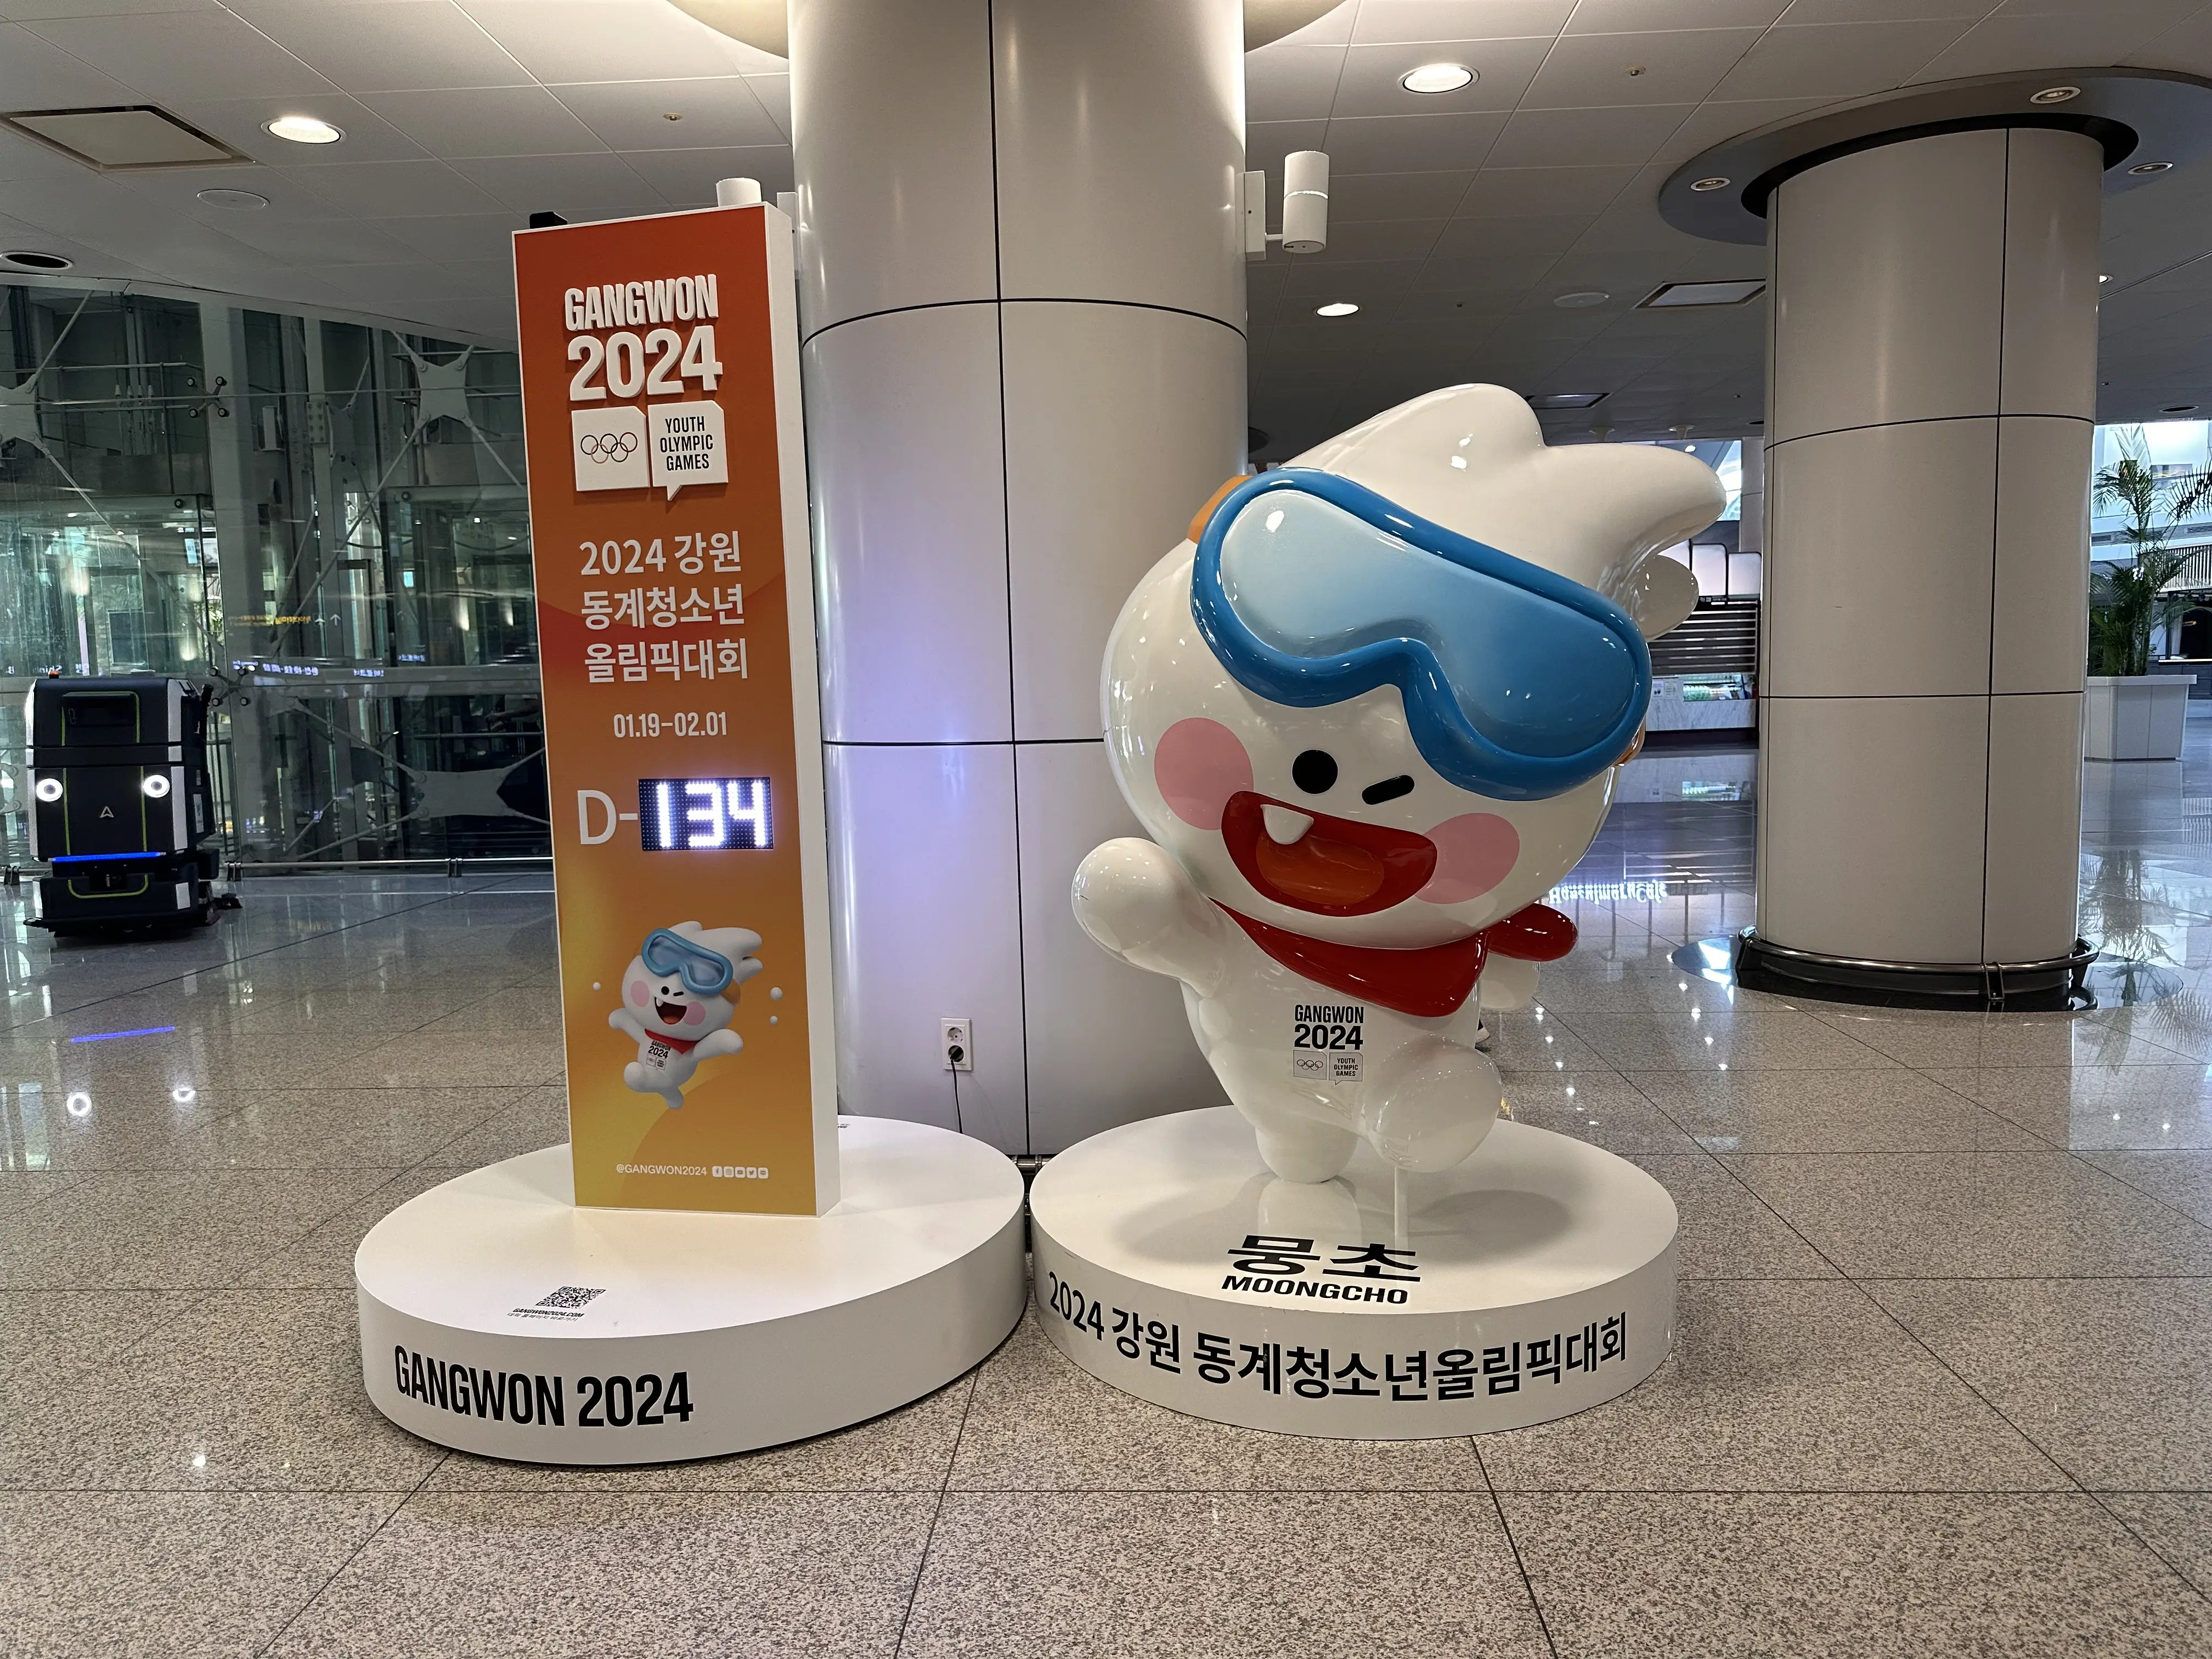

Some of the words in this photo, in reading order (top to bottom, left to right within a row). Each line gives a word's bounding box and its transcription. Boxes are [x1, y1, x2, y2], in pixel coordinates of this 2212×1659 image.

[564, 274, 719, 331] GANGWON
[568, 325, 723, 401] 2024
[665, 416, 705, 433] YOUTH
[660, 435, 713, 453] OLYMPIC
[666, 454, 709, 471] GAMES
[579, 538, 667, 575] 2024
[674, 531, 742, 574] 강원
[581, 584, 744, 630] 동계청소년
[584, 637, 748, 683] 올림픽대회
[1294, 1005, 1364, 1024] GANGWON
[648, 1046, 669, 1059] 2024
[1294, 1024, 1364, 1050] 2024
[616, 1164, 707, 1176] @GANGWON2024
[1228, 1235, 1422, 1283] 뭉초
[1222, 1275, 1410, 1304] MOONGCHO
[1049, 1272, 1104, 1340] 2024
[1111, 1307, 1181, 1373] 강원
[394, 1345, 565, 1426] GANGWON
[577, 1372, 693, 1427] 2024
